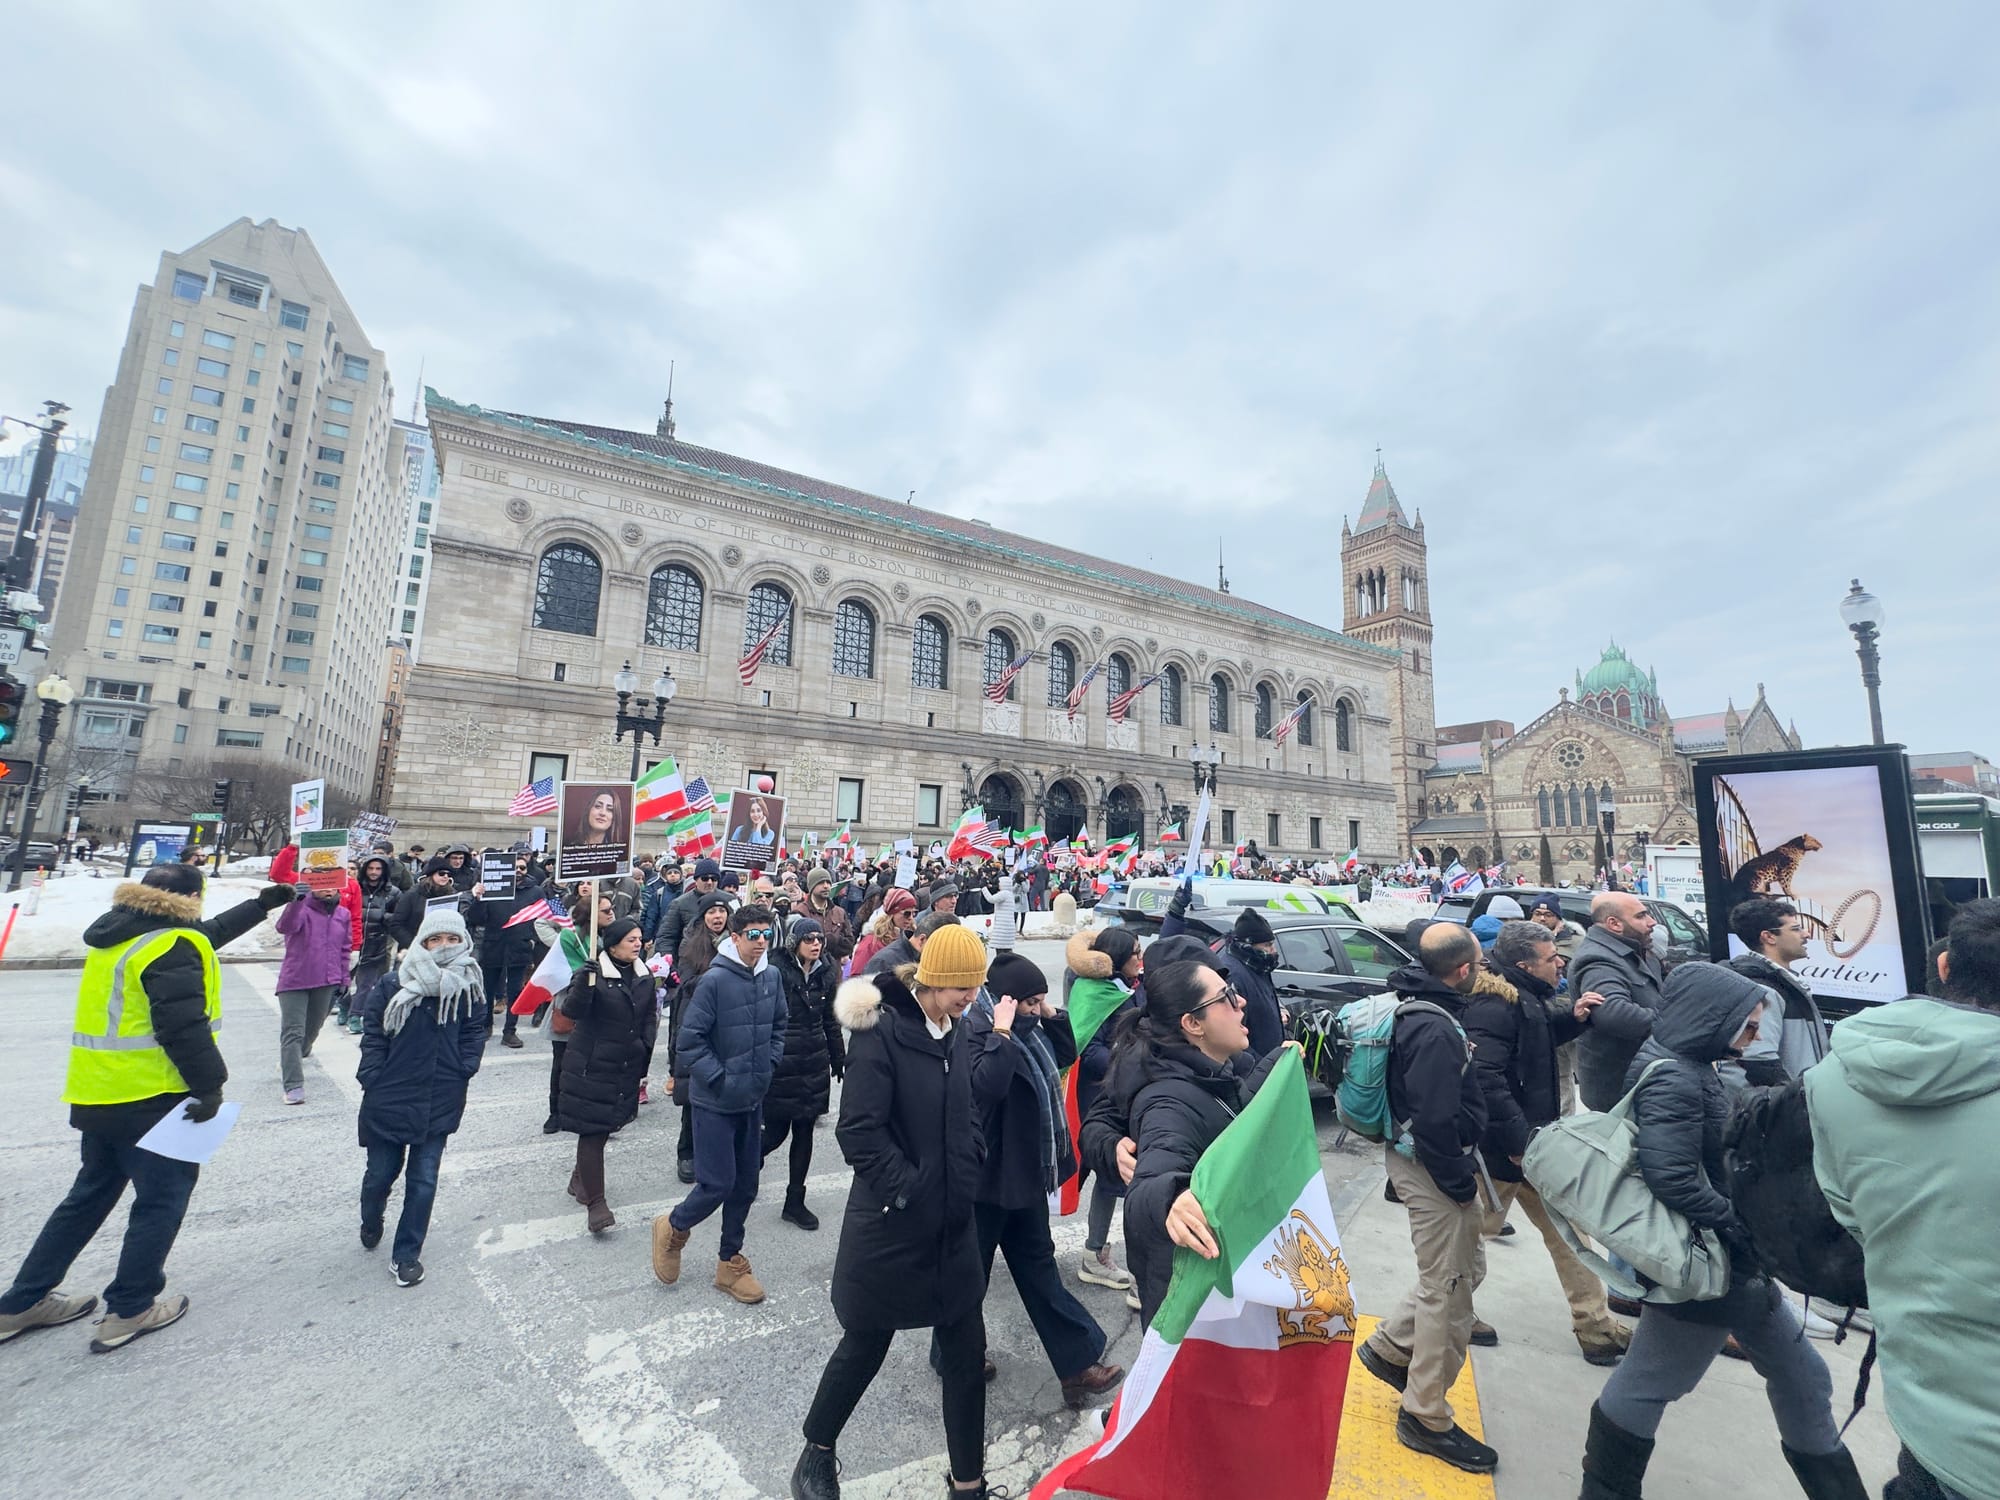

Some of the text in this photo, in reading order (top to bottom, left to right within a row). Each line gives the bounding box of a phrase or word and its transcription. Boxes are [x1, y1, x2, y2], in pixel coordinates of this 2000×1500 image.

[470, 464, 509, 486] THE
[526, 477, 590, 501] PUBLIC
[608, 496, 683, 524] LIBRARY
[694, 517, 717, 530] OF
[731, 524, 761, 540] THE
[771, 534, 808, 551] CITY
[820, 546, 840, 558] OF
[849, 551, 906, 575] BOSTON
[914, 569, 948, 585] BUILT
[958, 577, 974, 590] BY
[984, 583, 1008, 598] THE
[1016, 591, 1056, 610] PEOPLE
[1065, 603, 1087, 617] AND
[1094, 609, 1149, 631] DEDICATED
[1158, 625, 1169, 635] TO
[1175, 627, 1190, 639] THE
[1, 652, 15, 660] ED
[1932, 822, 1960, 830] GOLF
[1801, 964, 1887, 983] artier
